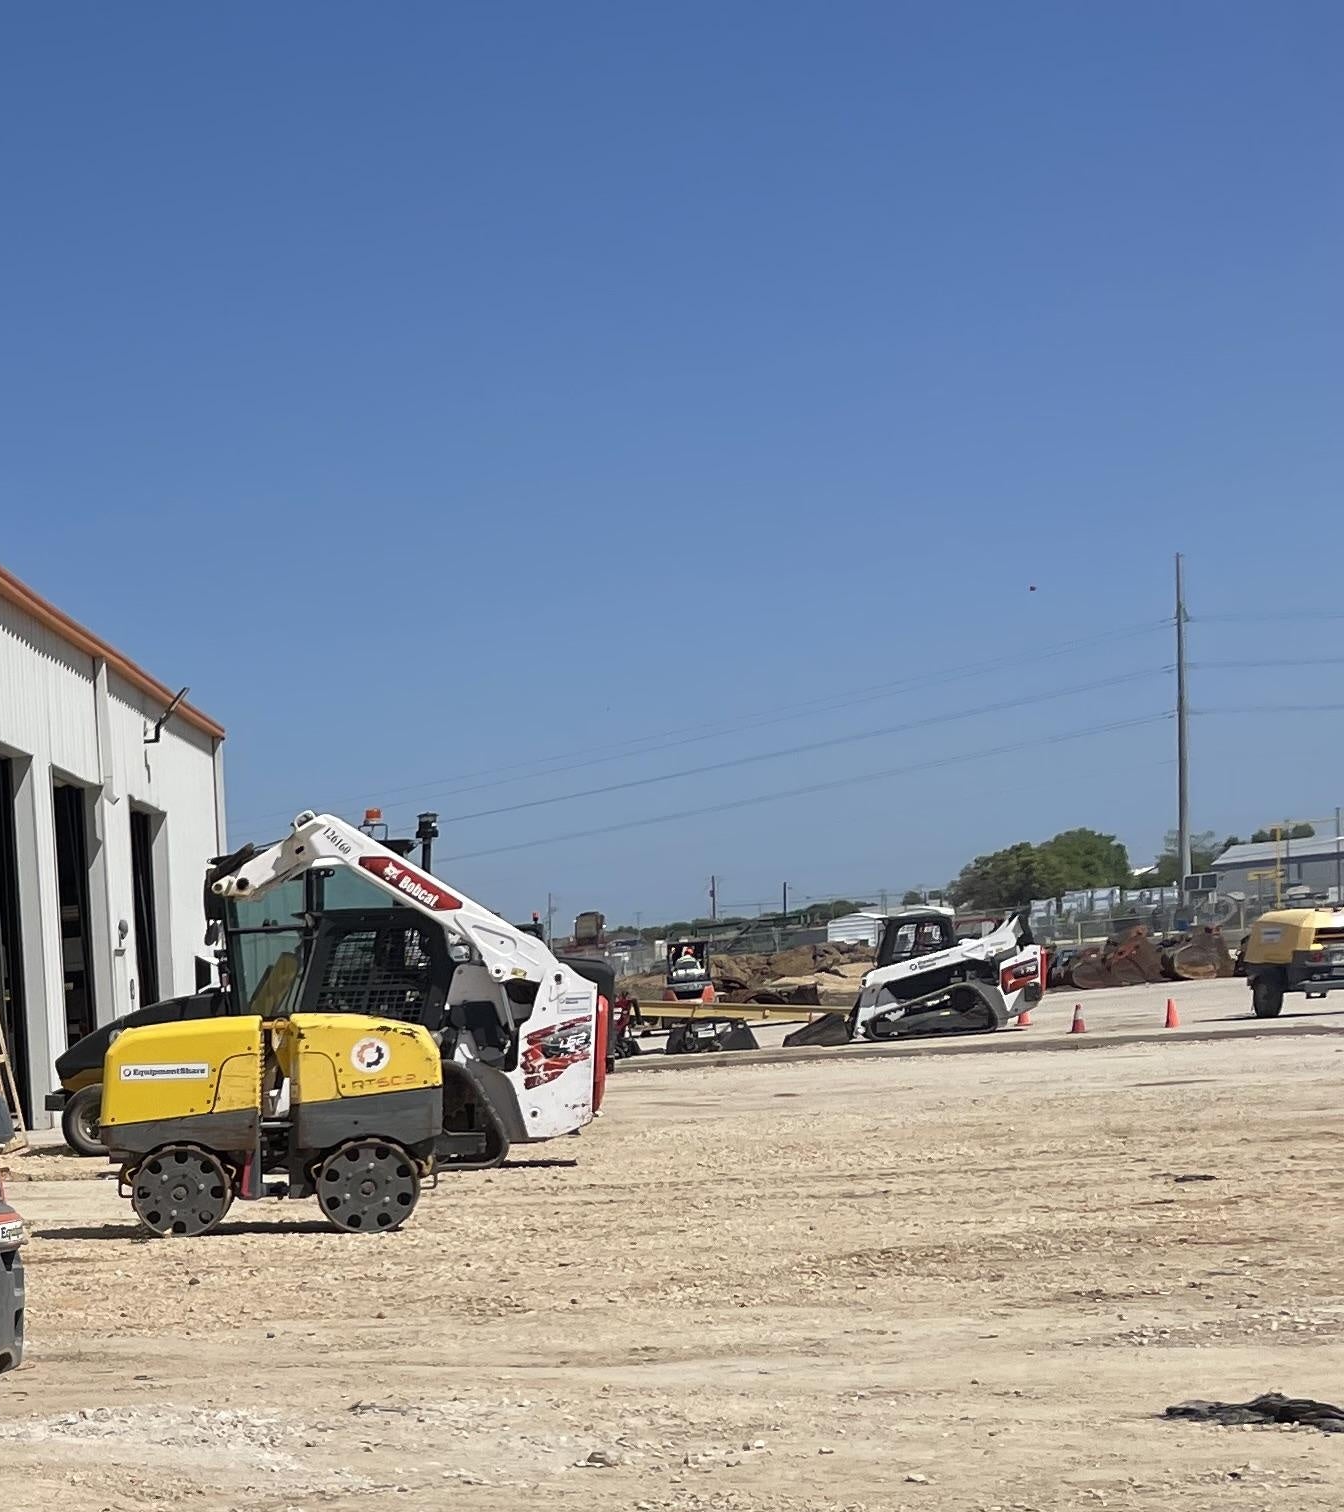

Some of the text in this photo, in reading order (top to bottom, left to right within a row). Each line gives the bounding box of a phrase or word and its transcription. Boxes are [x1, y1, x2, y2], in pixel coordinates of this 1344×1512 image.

[322, 827, 352, 855] 126160
[398, 875, 440, 908] Bobcat
[132, 1067, 206, 1077] EquipmentShare
